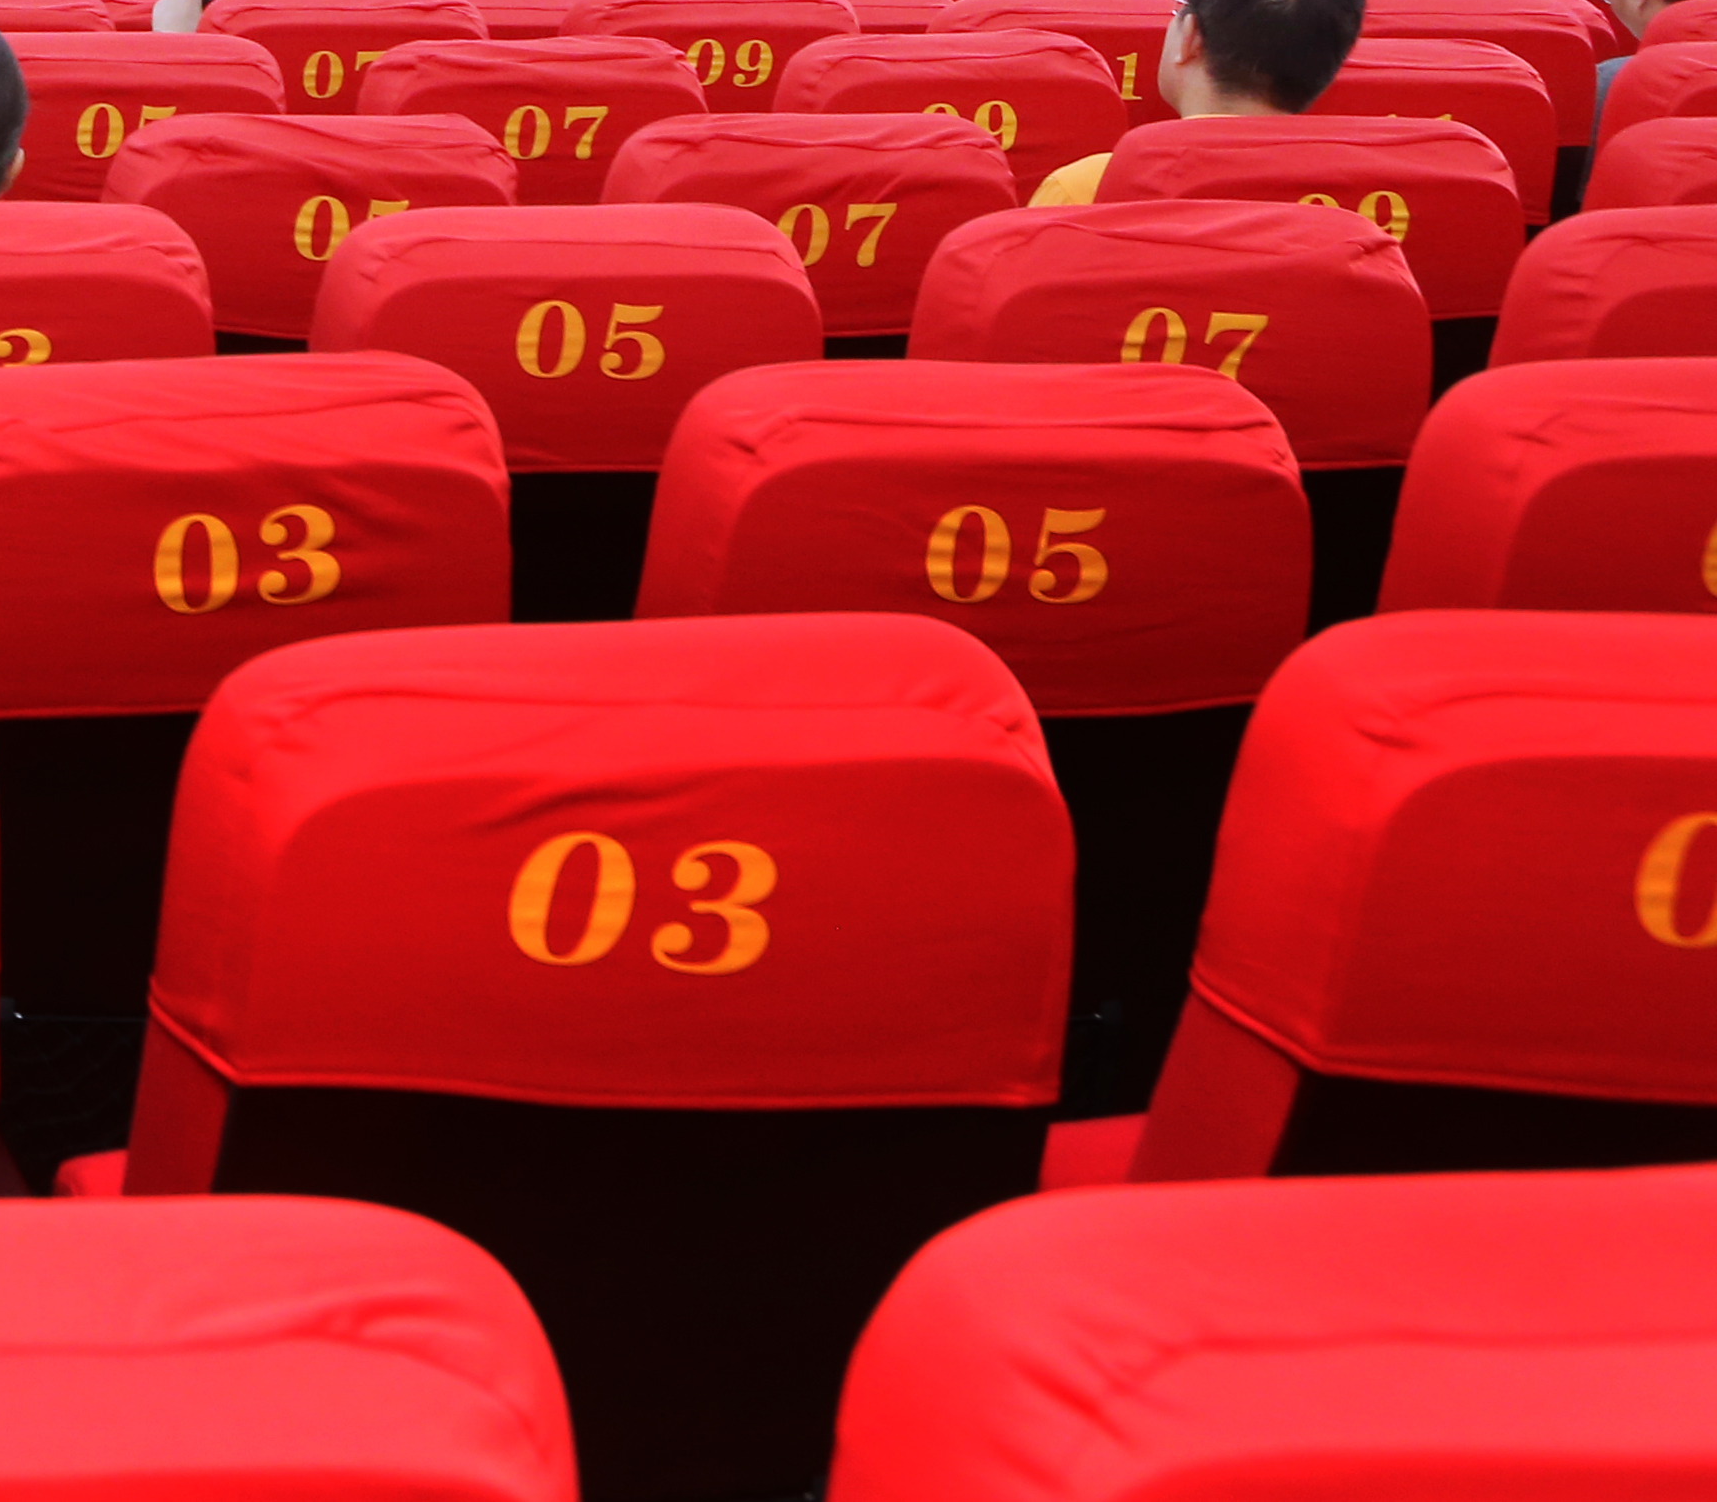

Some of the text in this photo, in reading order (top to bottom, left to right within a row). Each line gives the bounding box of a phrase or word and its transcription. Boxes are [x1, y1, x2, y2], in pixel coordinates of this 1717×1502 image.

[686, 38, 774, 88] 09
[503, 105, 609, 161] 07
[923, 100, 1018, 152] 9
[294, 195, 410, 262] 0
[776, 203, 897, 267] 07
[1298, 190, 1410, 244] 9
[517, 300, 664, 380] 05
[1121, 306, 1269, 380] 07
[152, 502, 342, 616] 03
[924, 504, 1109, 604] 05
[508, 831, 778, 976] 03
[1635, 812, 1717, 950] 0
